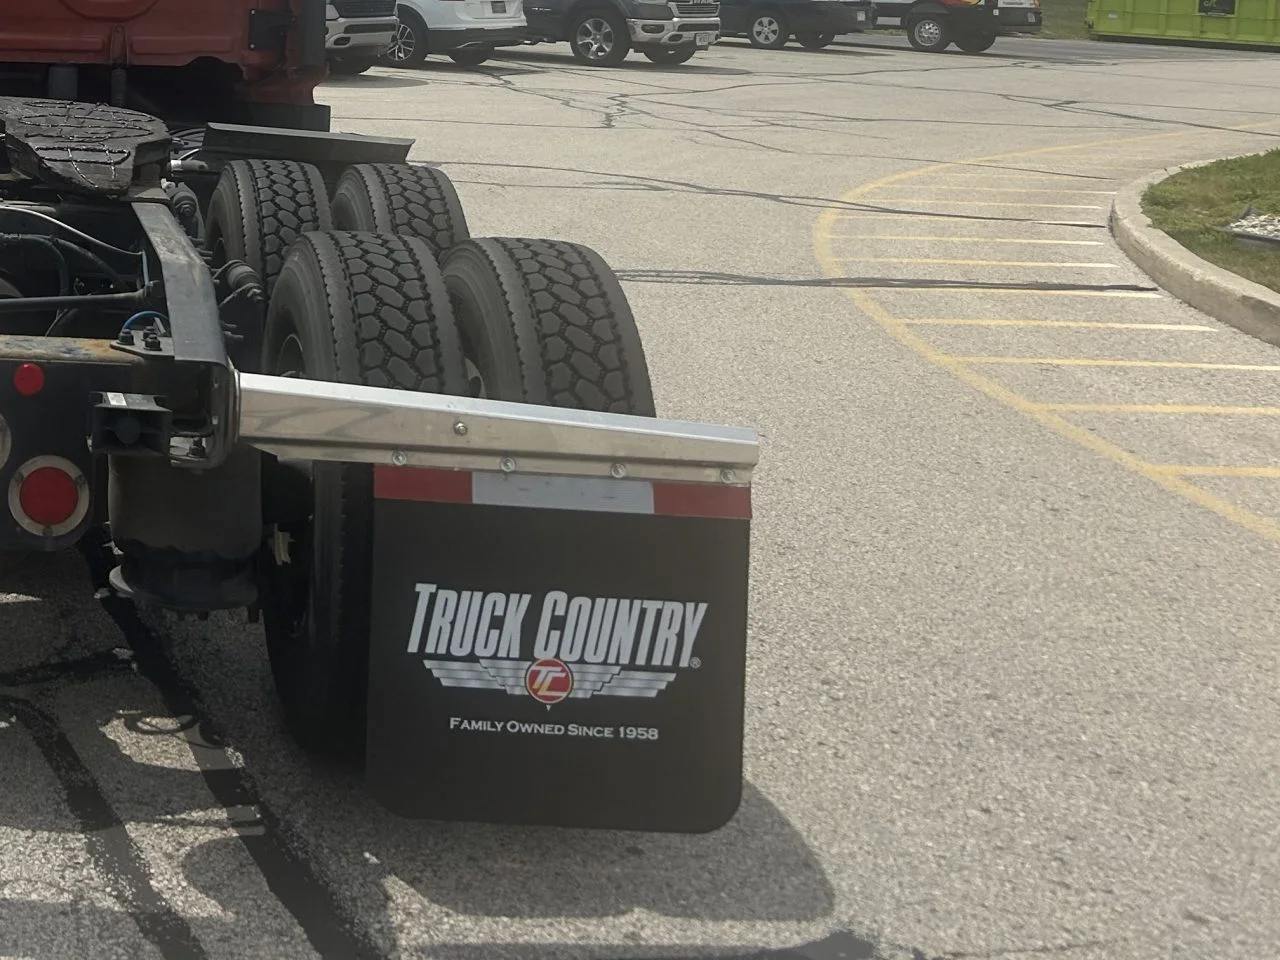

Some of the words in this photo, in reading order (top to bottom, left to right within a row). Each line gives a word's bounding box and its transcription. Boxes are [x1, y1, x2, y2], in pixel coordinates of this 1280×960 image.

[407, 583, 532, 659] TRUCK
[531, 666, 569, 696] TC
[449, 717, 504, 732] FAMILY
[506, 720, 565, 735] OWNED
[567, 723, 614, 738] SINCE
[619, 726, 659, 740] 1958
